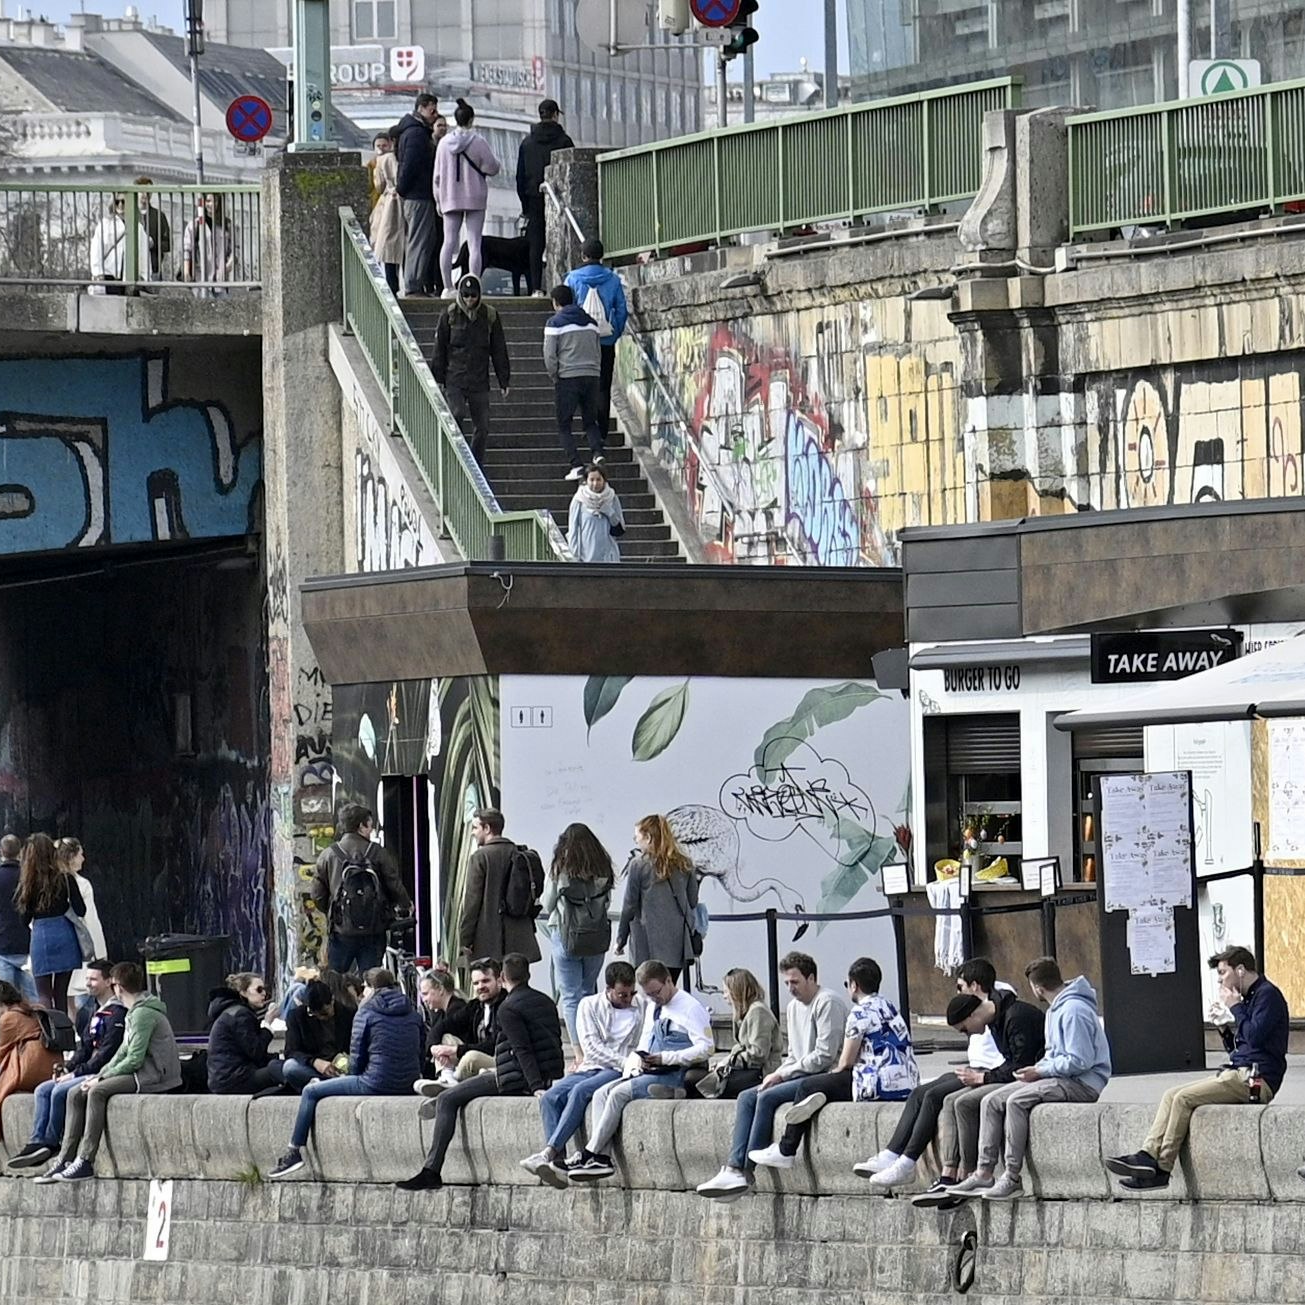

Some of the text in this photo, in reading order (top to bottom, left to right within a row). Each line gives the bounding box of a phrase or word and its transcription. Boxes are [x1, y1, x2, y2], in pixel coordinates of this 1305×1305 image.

[330, 64, 386, 83] ROUP
[1108, 650, 1224, 674] TAKE AWAY
[943, 665, 1021, 692] BURGER TO GO
